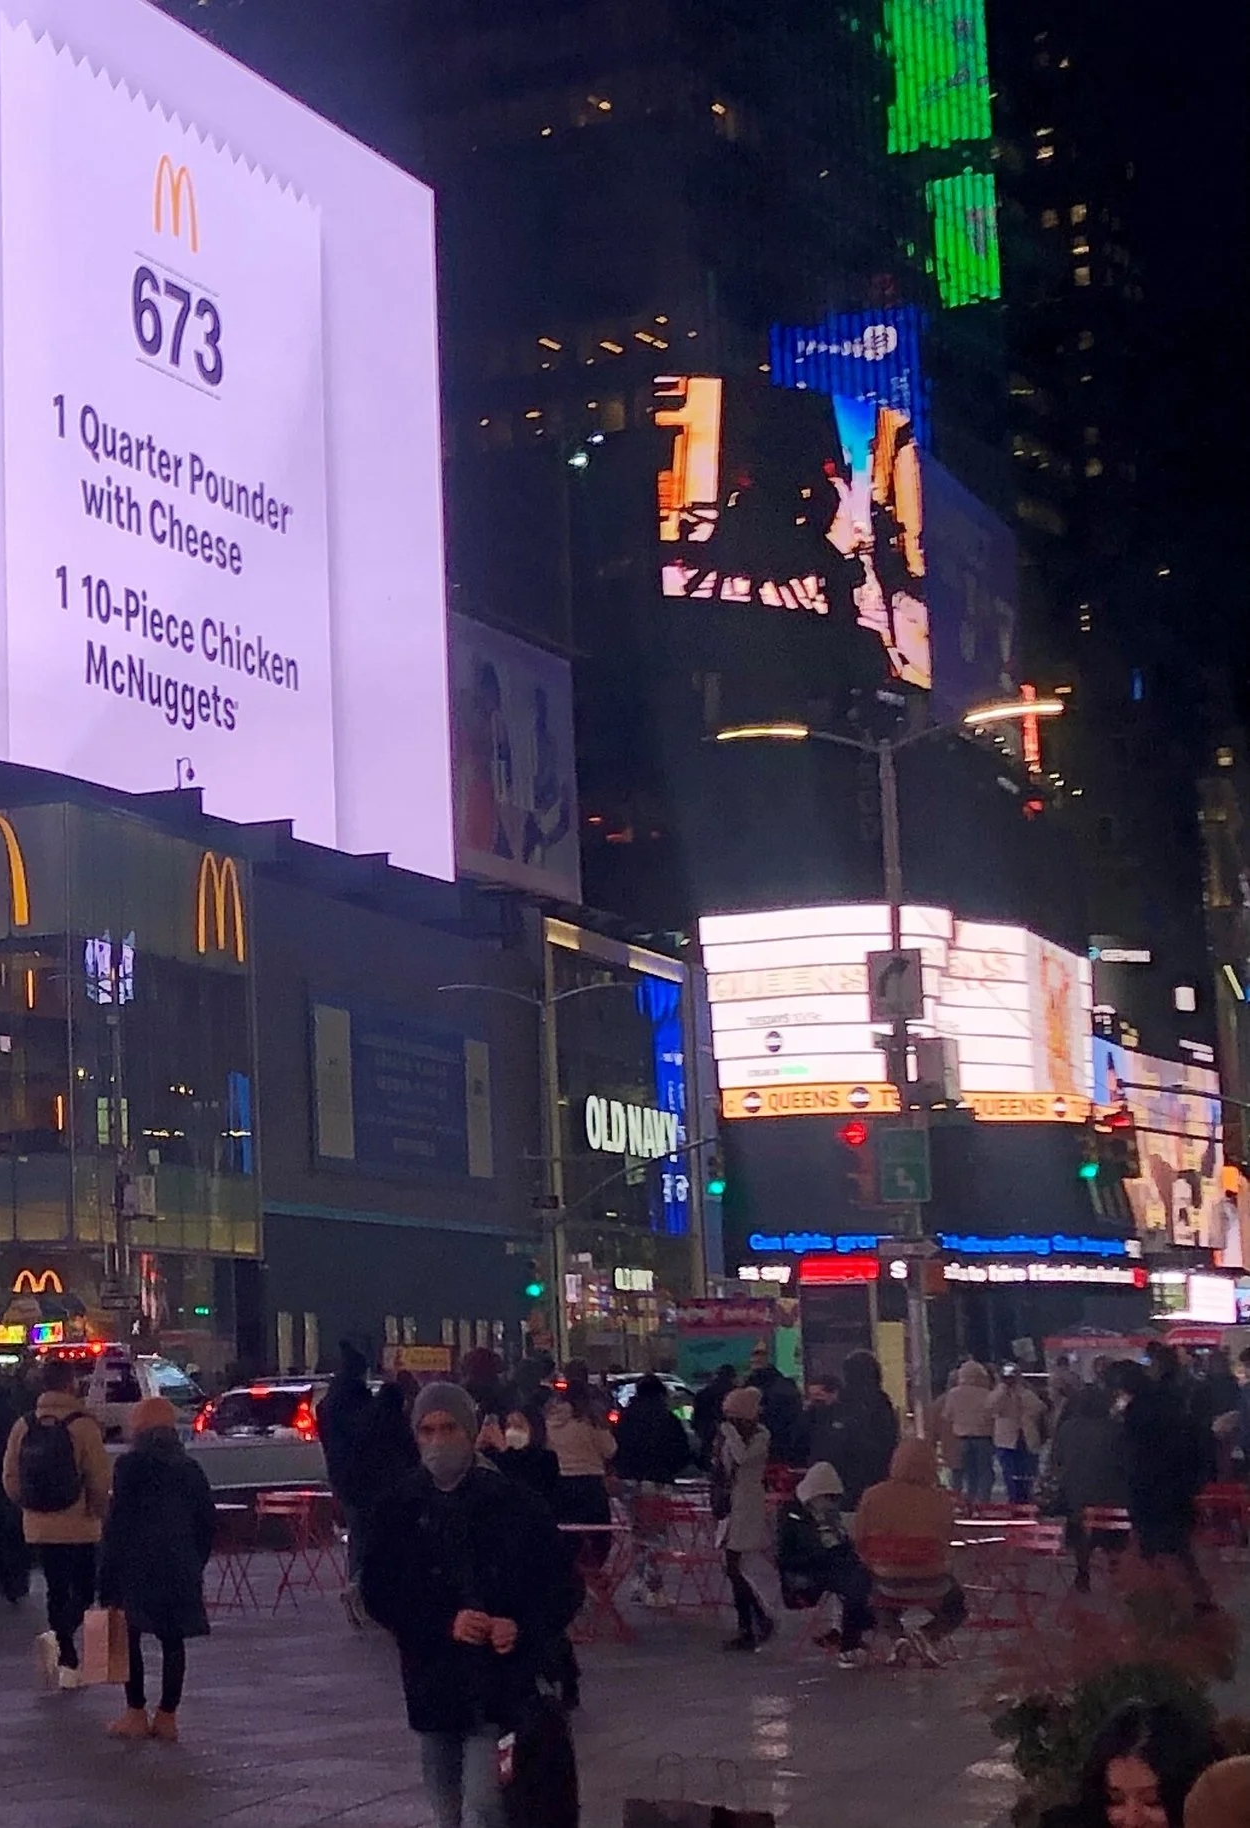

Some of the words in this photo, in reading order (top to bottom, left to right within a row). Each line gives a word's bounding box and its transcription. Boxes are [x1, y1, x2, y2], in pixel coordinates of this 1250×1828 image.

[132, 266, 223, 387] 673
[53, 395, 67, 439] 1
[80, 405, 182, 487] Quarter
[189, 453, 291, 534] Pounder
[82, 477, 142, 537] with
[150, 500, 243, 576] Cheese
[56, 566, 69, 610] 1
[82, 574, 194, 655] 10-Piece
[201, 617, 299, 692] Chicken
[86, 641, 237, 731] McNuggets
[586, 1095, 626, 1153] OLD
[627, 1104, 679, 1162] NAVY
[768, 1090, 839, 1111] QUEENS
